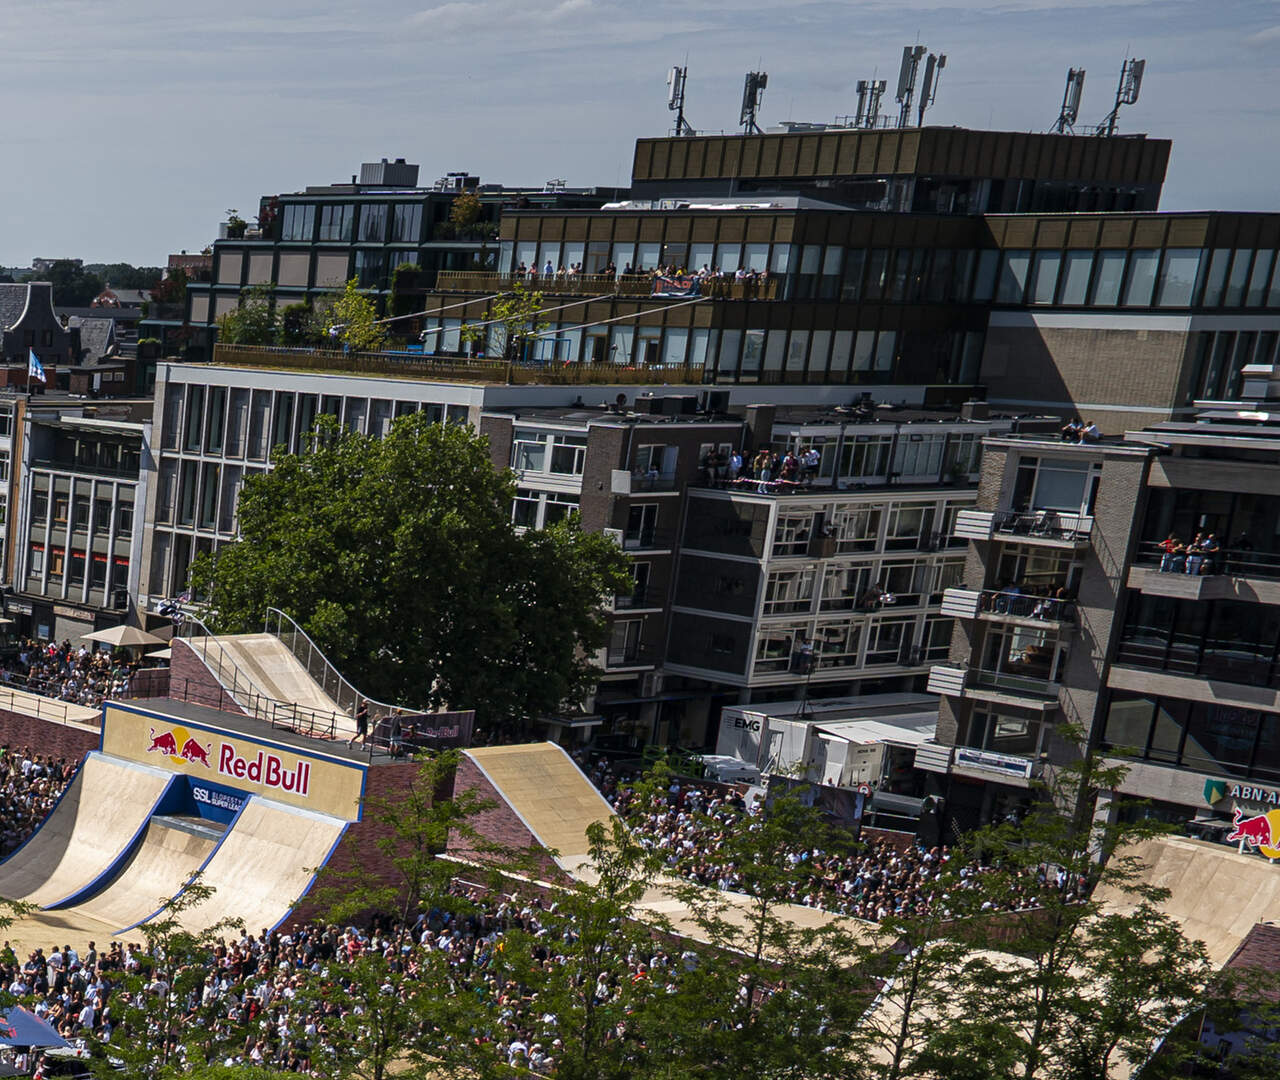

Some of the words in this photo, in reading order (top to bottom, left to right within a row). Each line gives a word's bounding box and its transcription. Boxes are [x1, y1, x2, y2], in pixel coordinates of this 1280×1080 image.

[735, 718, 761, 732] EMG
[219, 742, 264, 784] Red
[264, 754, 311, 796] Bull
[193, 787, 211, 803] SSL
[1230, 784, 1280, 804] ABN·A
